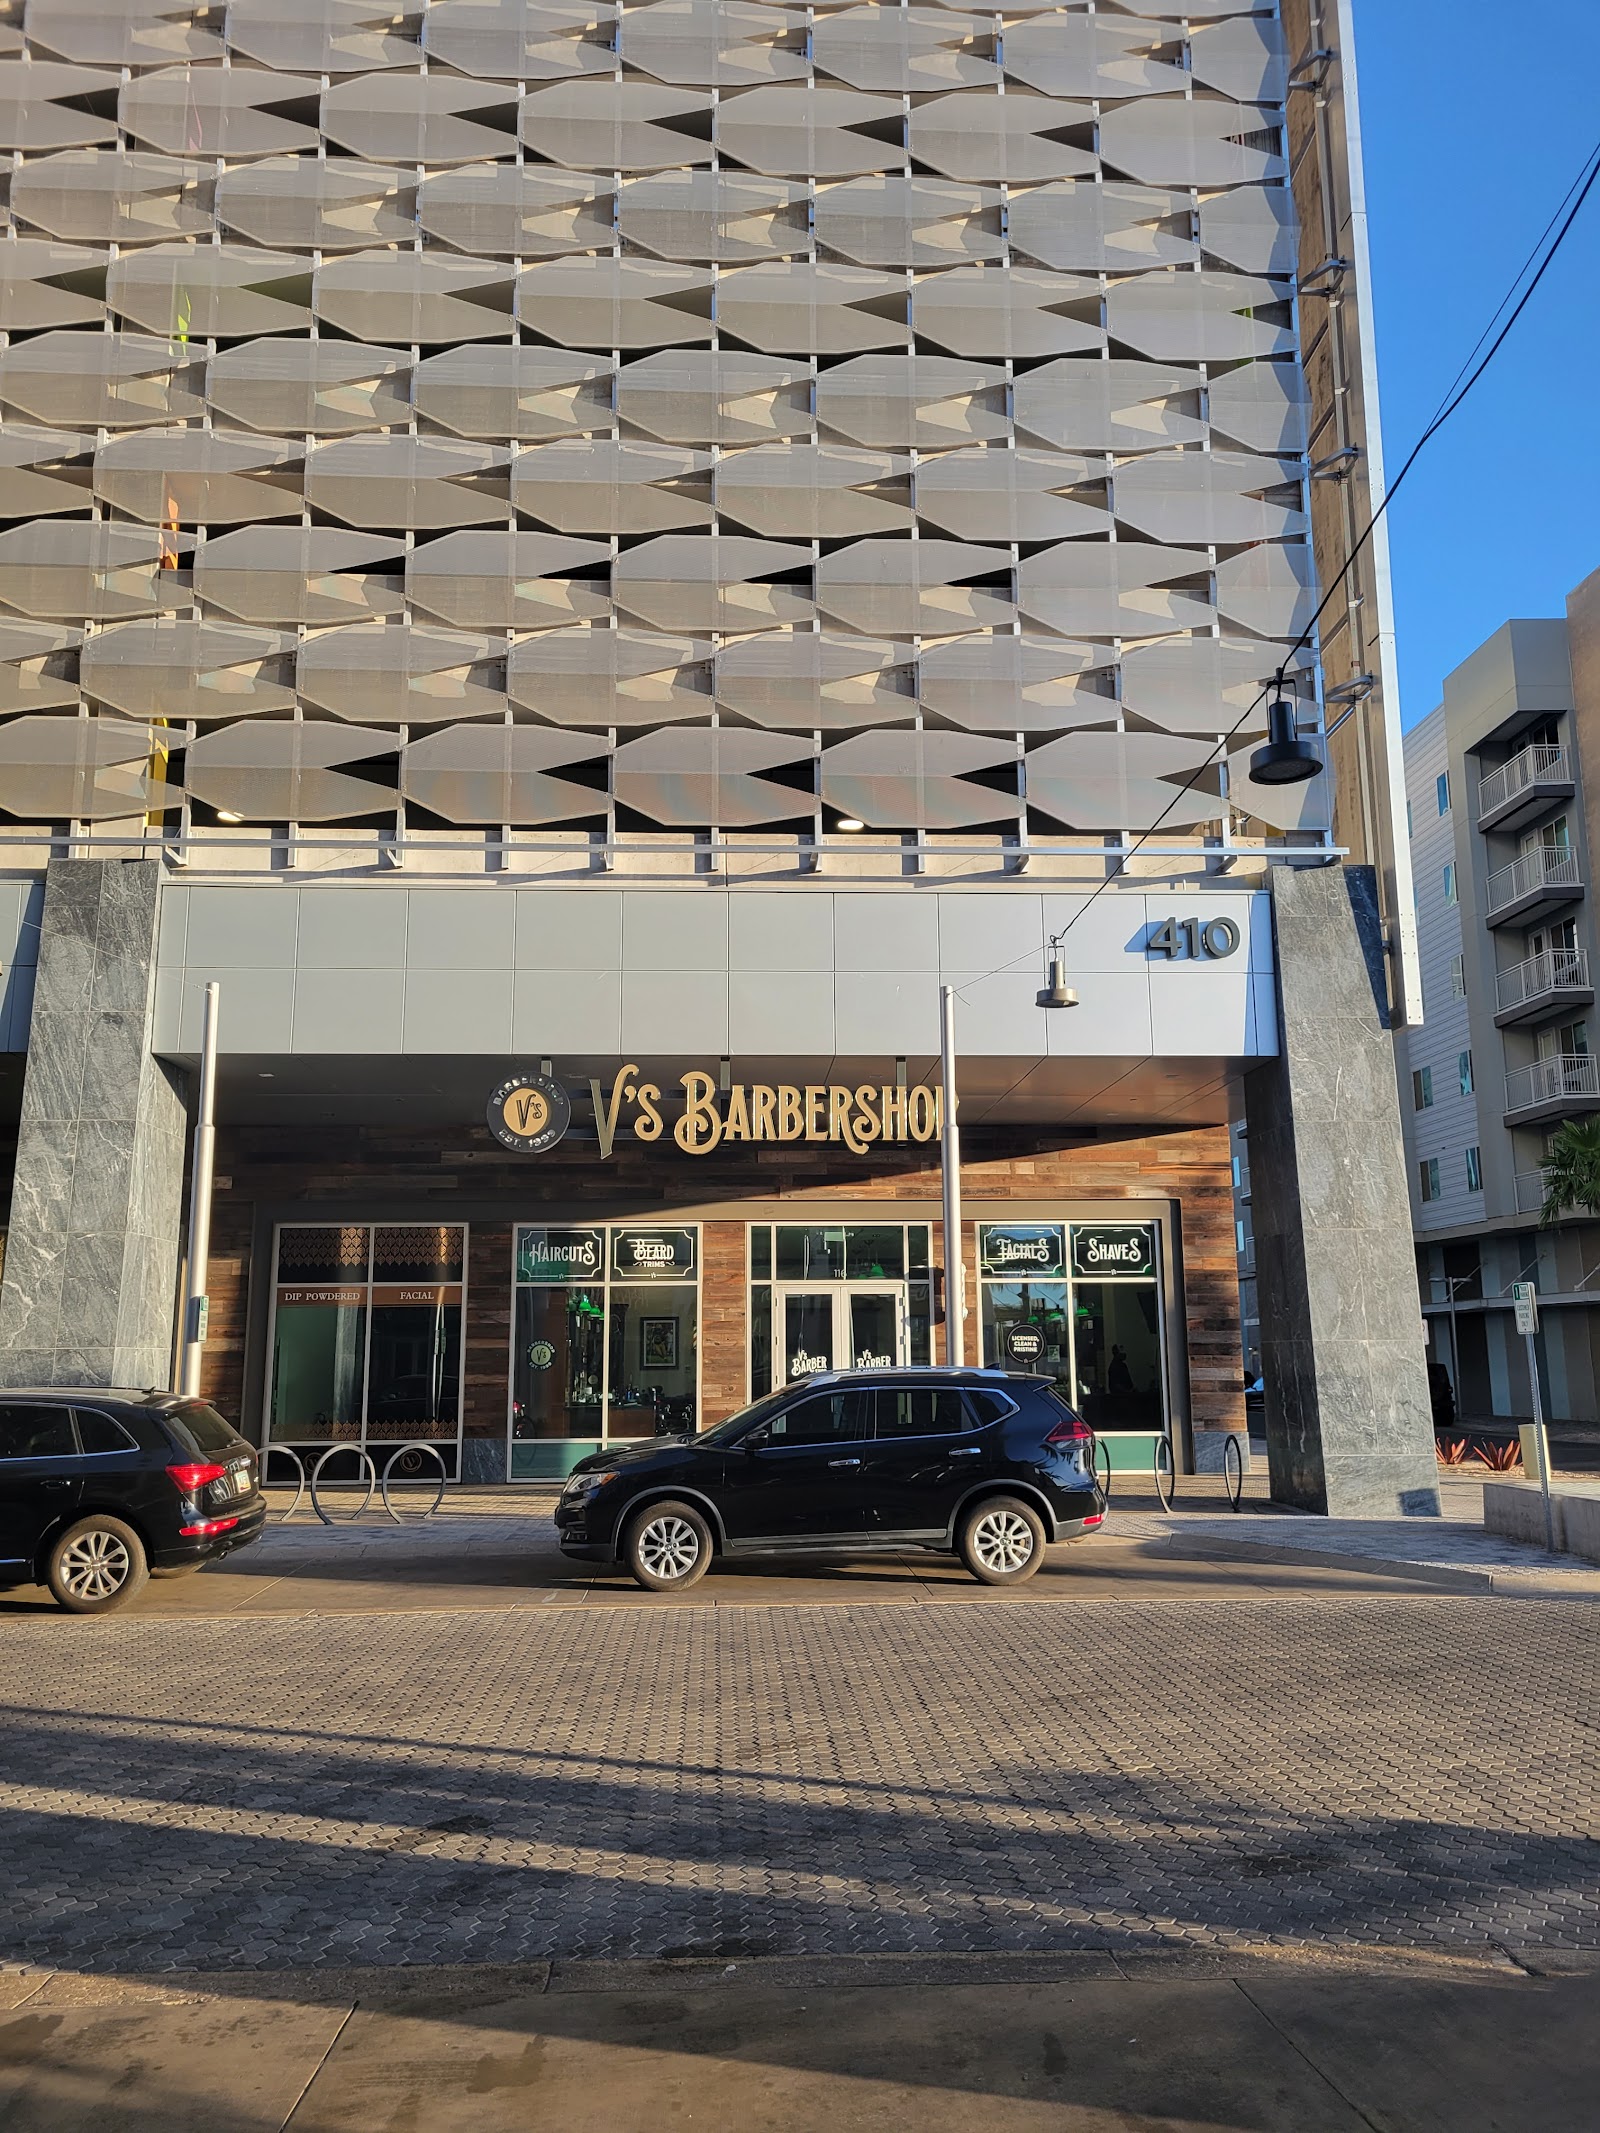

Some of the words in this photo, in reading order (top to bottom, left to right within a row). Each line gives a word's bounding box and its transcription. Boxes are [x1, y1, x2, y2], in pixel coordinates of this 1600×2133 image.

[1150, 917, 1240, 958] 410
[529, 1241, 595, 1266] HAIRCUTS
[996, 1238, 1050, 1262] FACIALS
[1087, 1238, 1141, 1262] SHAVES
[285, 1292, 301, 1301] DIP
[306, 1292, 360, 1301] POWDERED
[400, 1291, 434, 1300] FACIAL
